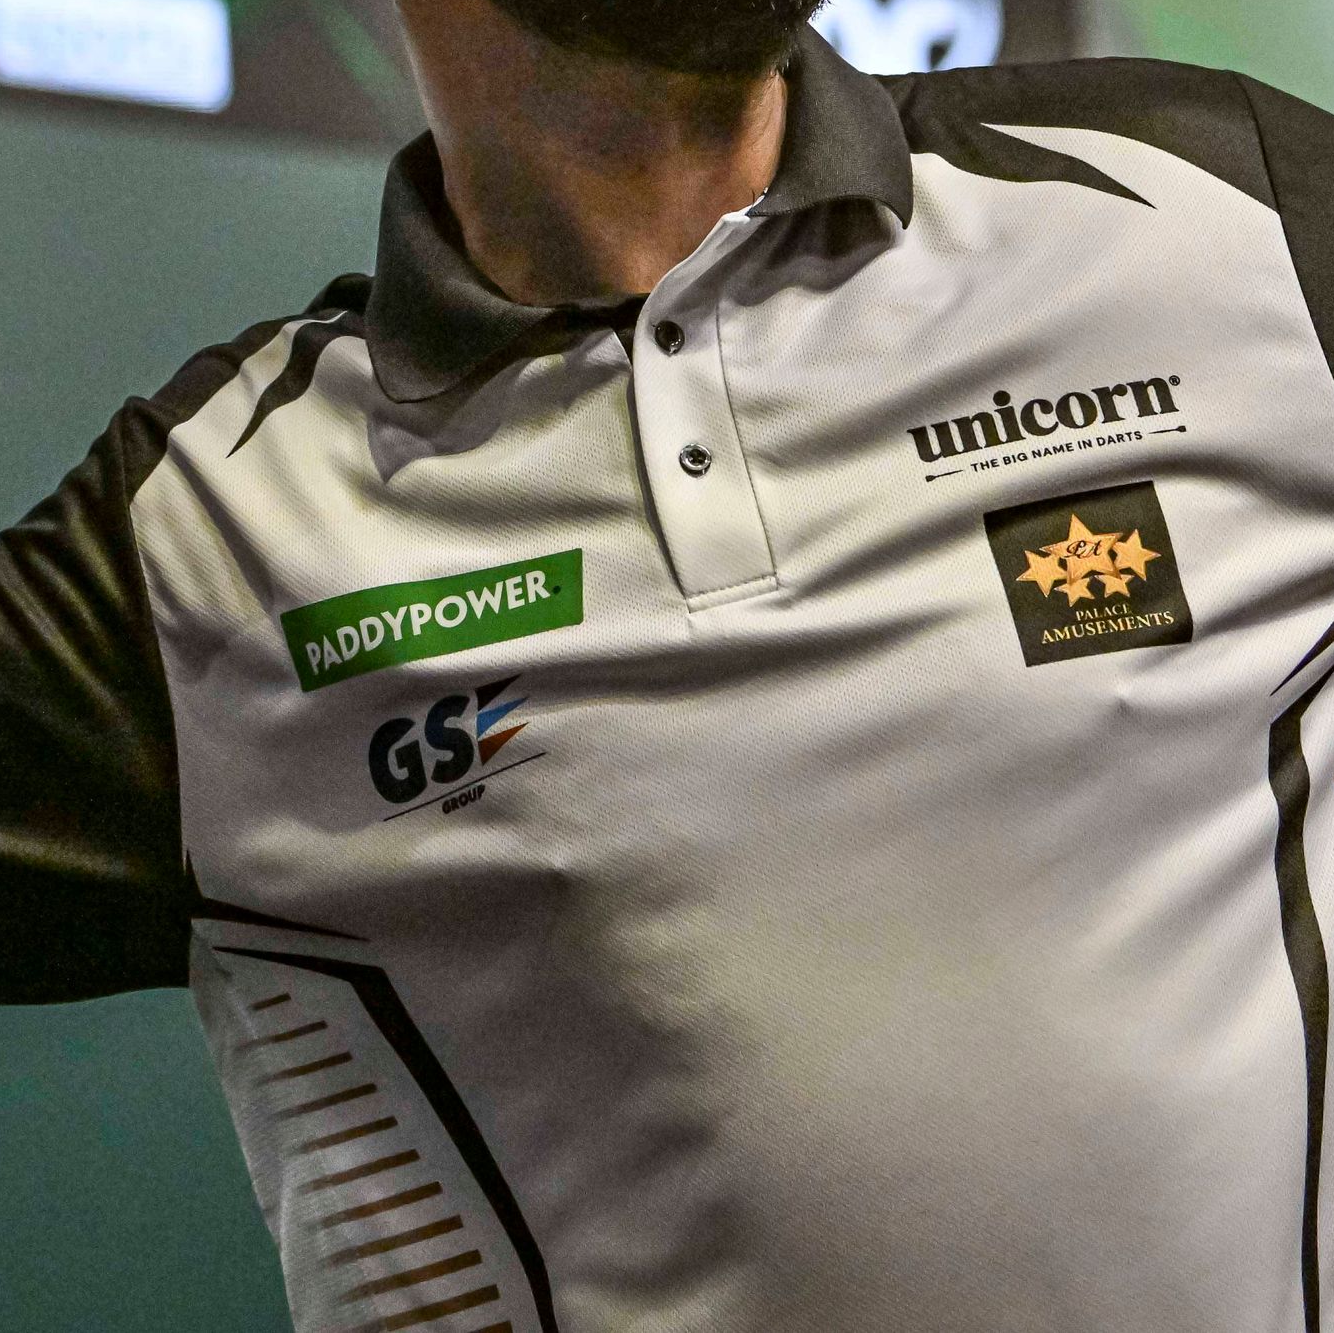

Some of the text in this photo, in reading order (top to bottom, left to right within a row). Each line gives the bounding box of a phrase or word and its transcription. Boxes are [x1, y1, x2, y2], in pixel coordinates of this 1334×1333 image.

[970, 430, 1143, 472] THE BIG NAME IN DARTS
[1041, 610, 1175, 644] AMUSEMENTS
[1075, 603, 1132, 622] PALACE
[441, 785, 486, 815] GROUP
